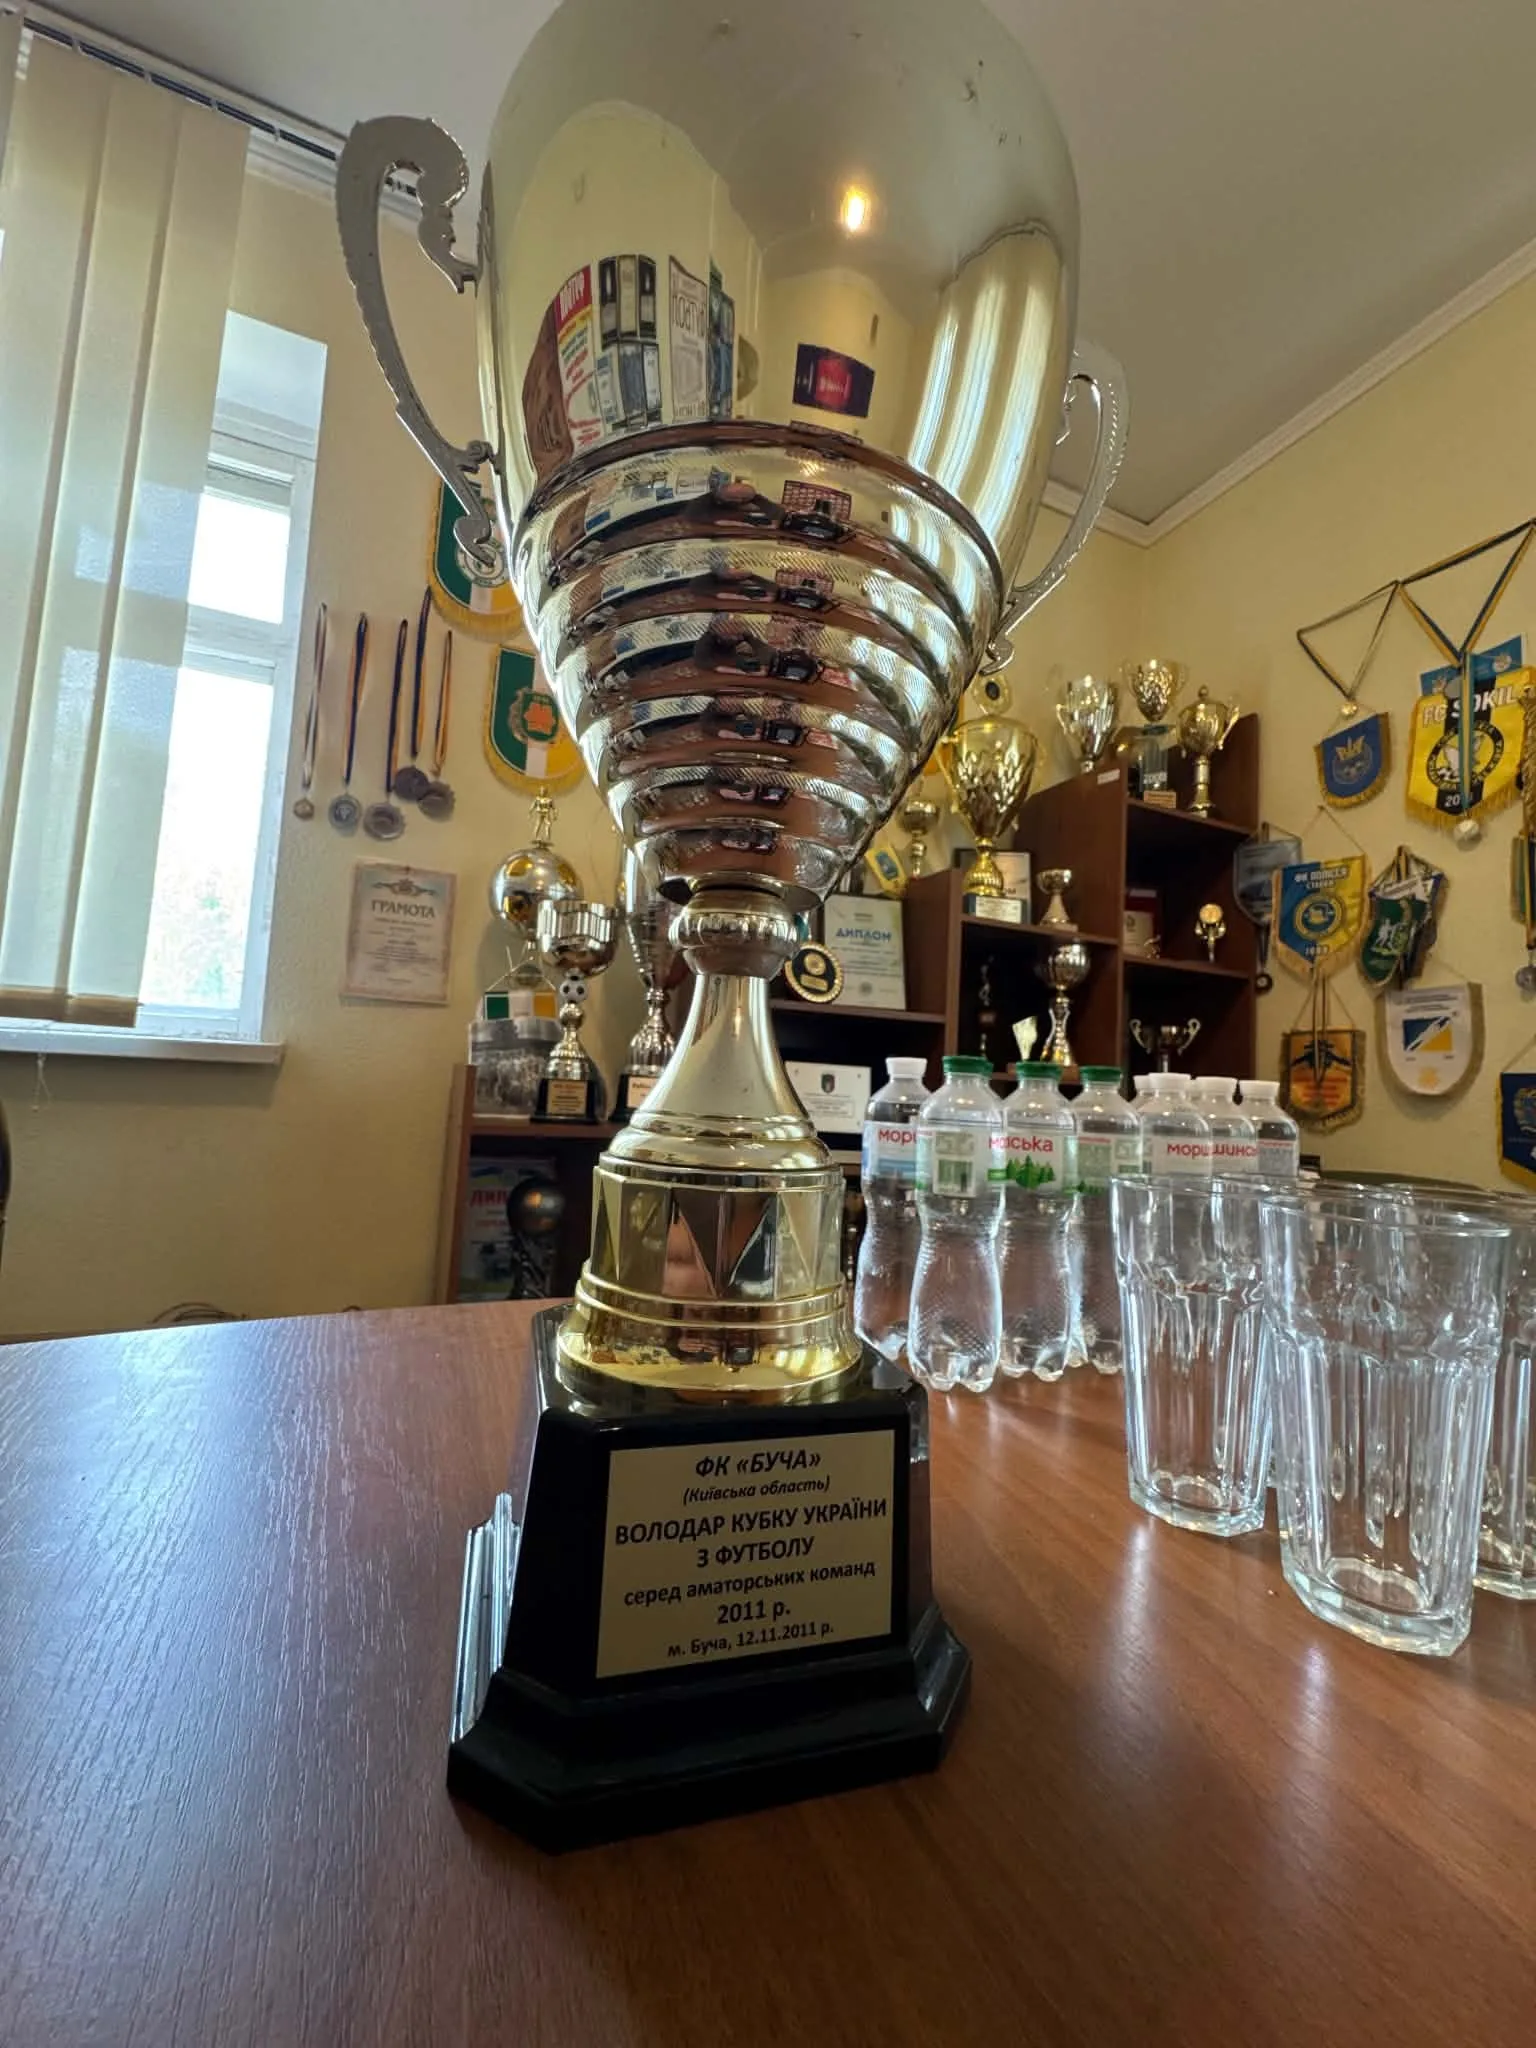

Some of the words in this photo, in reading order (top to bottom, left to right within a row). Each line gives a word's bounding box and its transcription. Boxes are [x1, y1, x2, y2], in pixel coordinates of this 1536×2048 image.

[370, 899, 436, 918] ГРАМОТА
[835, 928, 892, 942] ДИПЛОМ
[470, 1190, 508, 1207] ДИП
[695, 1455, 731, 1478] ФК
[736, 1449, 821, 1474] «БУЧА»
[683, 1486, 756, 1506] (Київська
[760, 1475, 831, 1497] область)
[615, 1515, 725, 1545] ВОЛОДАР
[731, 1507, 799, 1533] КУБКУ
[803, 1497, 887, 1525] УКРАЇНИ
[715, 1536, 815, 1566] ФУТБОЛУ
[623, 1583, 681, 1607] серед
[686, 1570, 805, 1598] аматорських
[809, 1560, 876, 1581] команд
[717, 1600, 766, 1625] 2011
[771, 1602, 791, 1622] р.
[667, 1643, 686, 1657] м.
[690, 1635, 732, 1655] Буча,
[736, 1621, 817, 1647] 12.11.2011
[820, 1623, 834, 1637] р.
